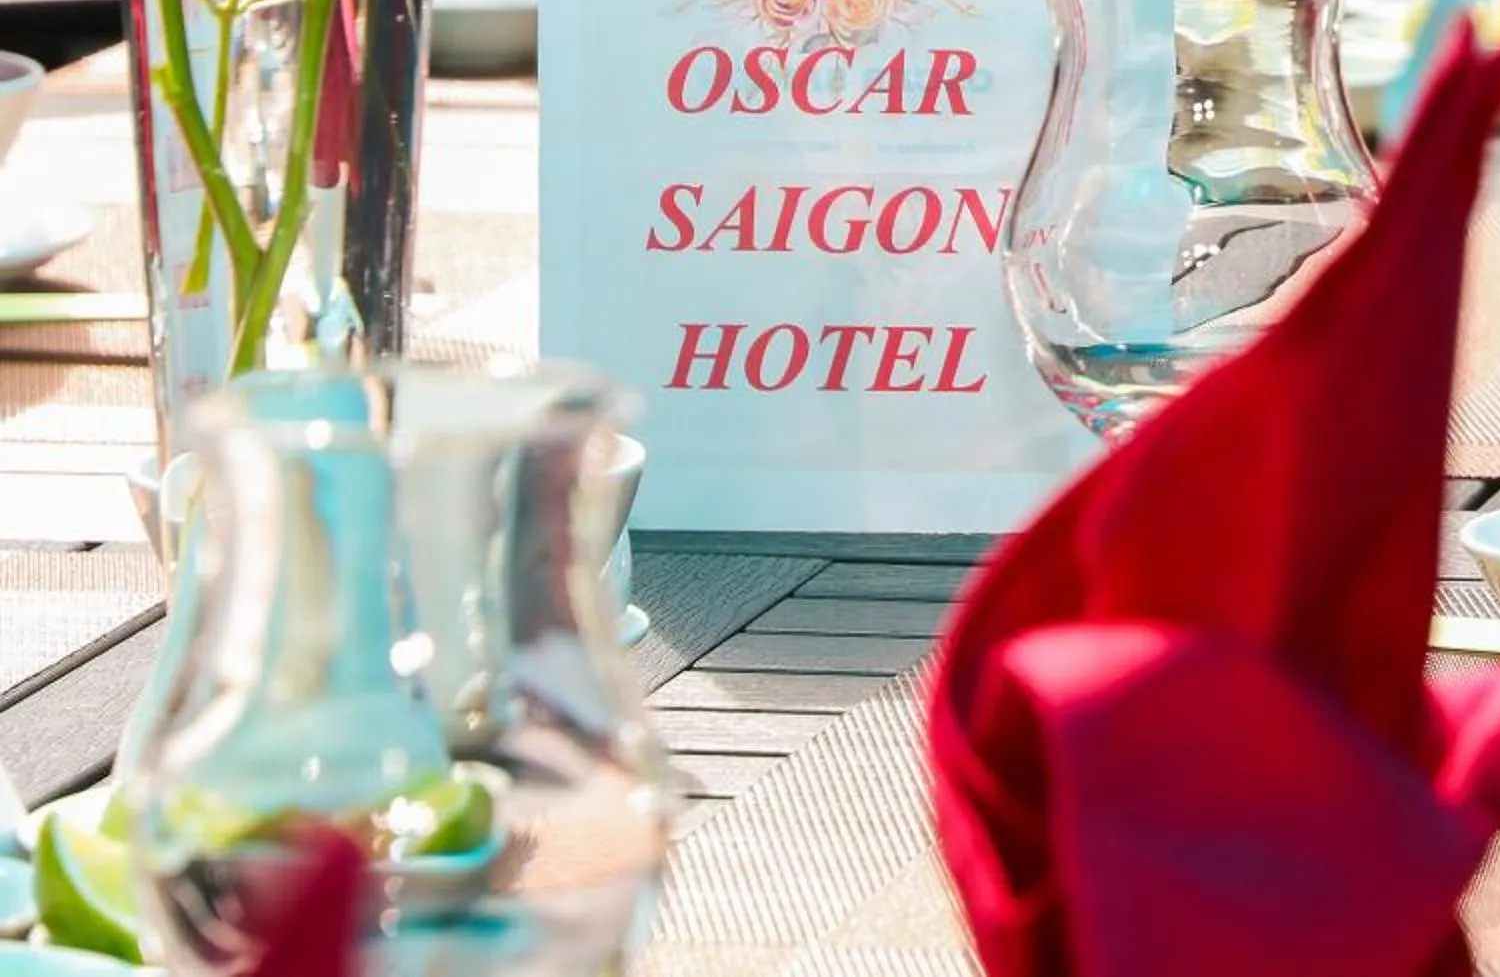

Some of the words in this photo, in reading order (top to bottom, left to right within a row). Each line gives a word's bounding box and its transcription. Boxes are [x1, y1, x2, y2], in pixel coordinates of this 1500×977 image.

[666, 45, 978, 117] OSCAR
[646, 183, 1011, 256] SAIGON
[662, 323, 988, 394] HOTEL
